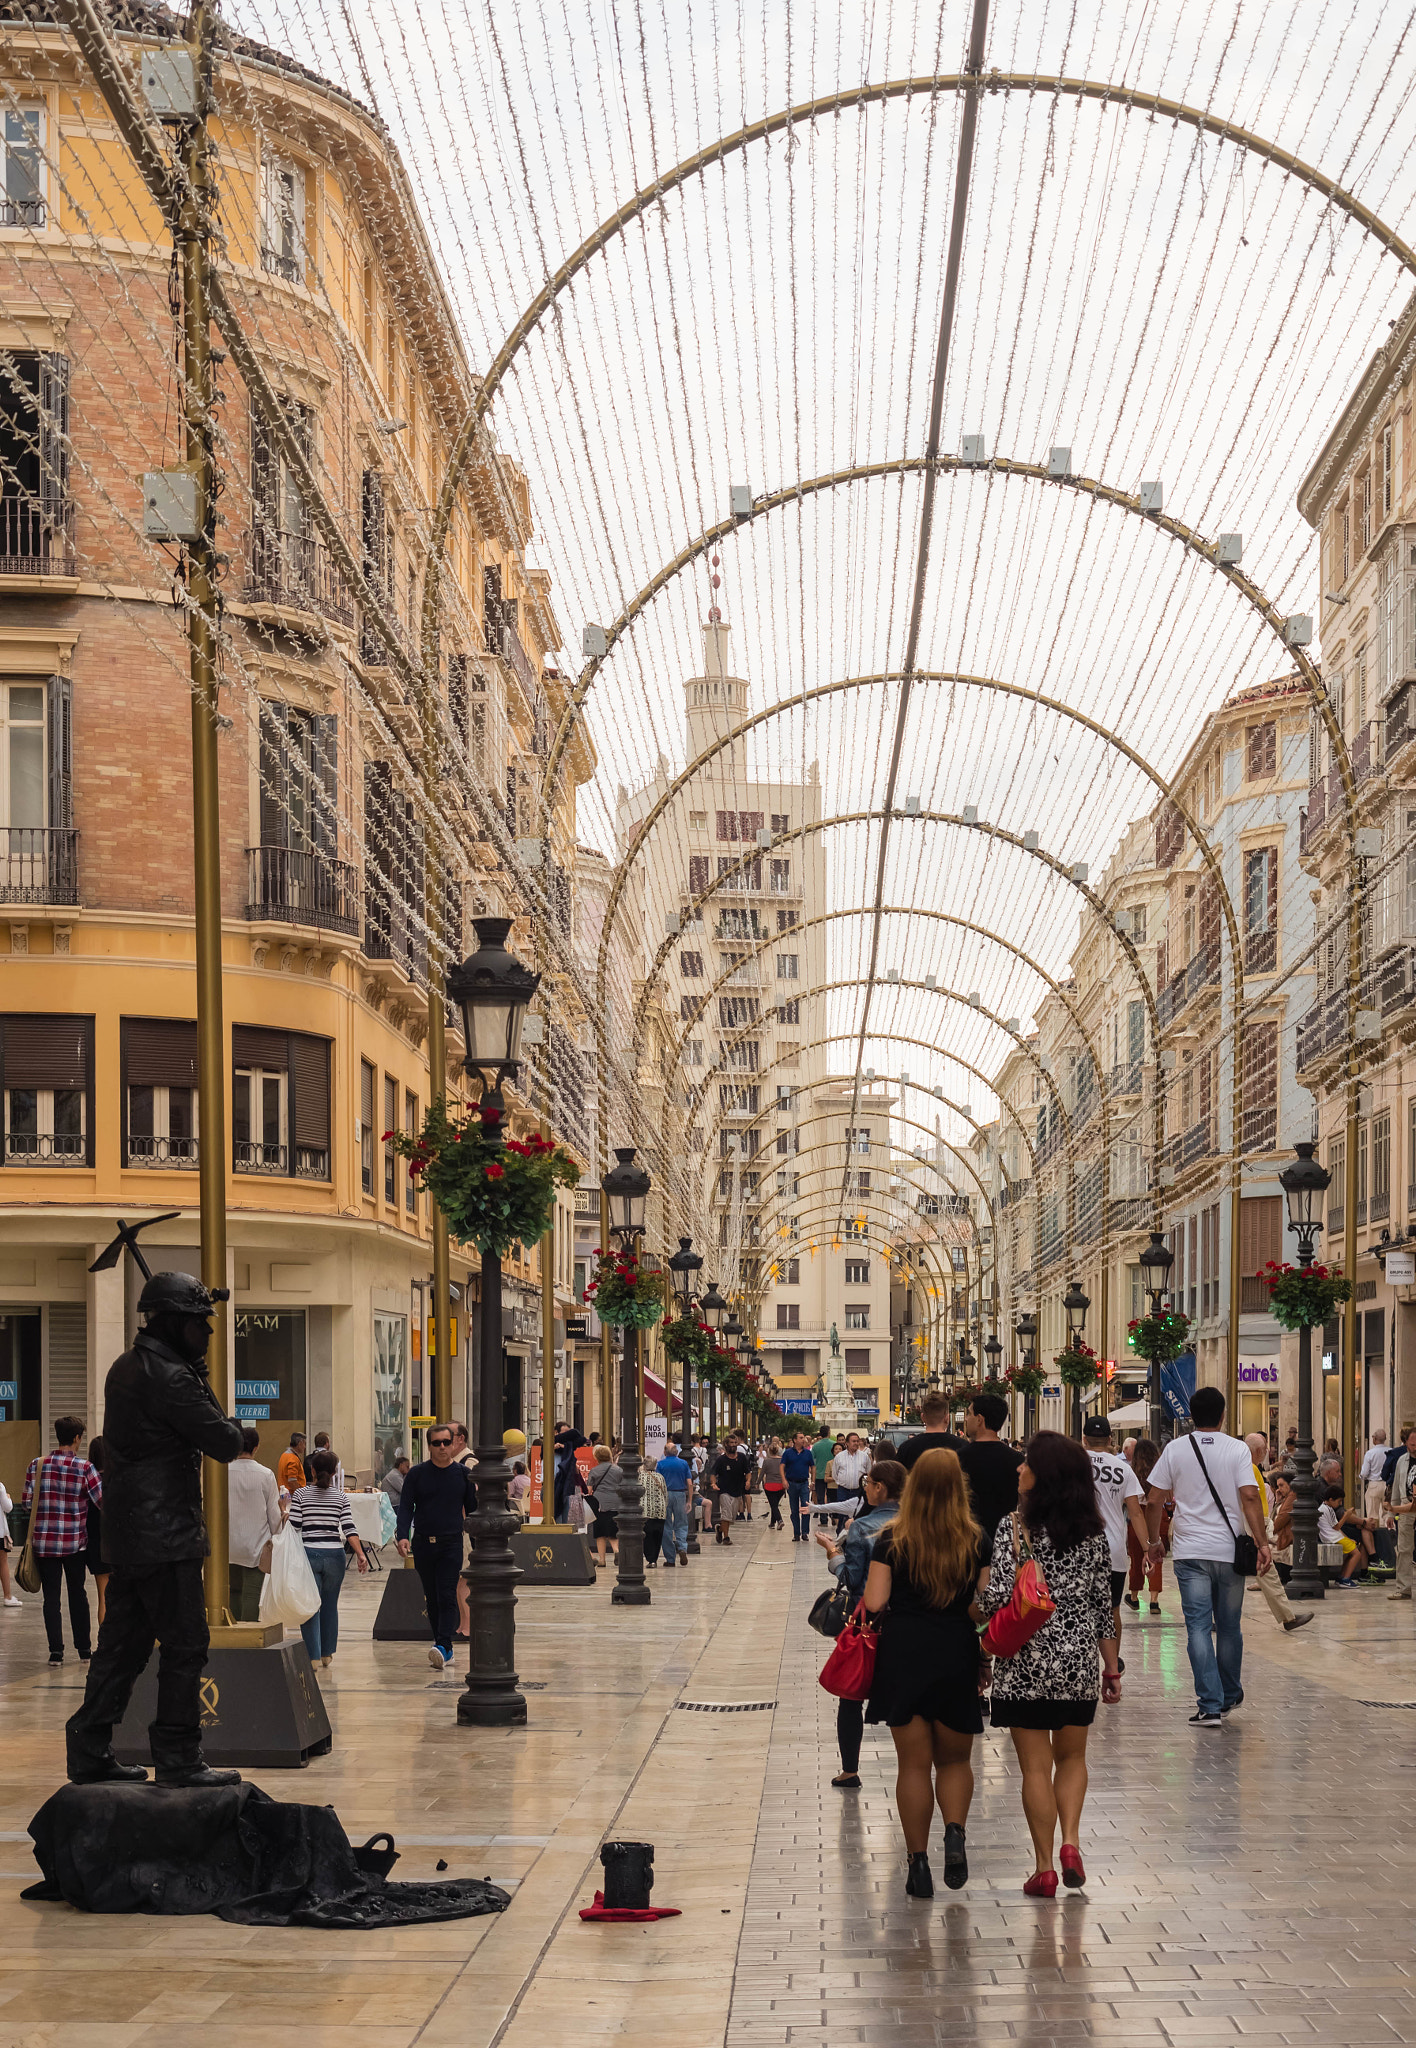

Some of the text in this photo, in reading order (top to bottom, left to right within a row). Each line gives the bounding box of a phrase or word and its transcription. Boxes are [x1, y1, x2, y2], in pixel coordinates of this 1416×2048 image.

[1238, 1362, 1278, 1382] laire's
[235, 1380, 278, 1396] IDACIÓN
[1166, 1389, 1186, 1416] SUR
[240, 1407, 268, 1417] CIERRE
